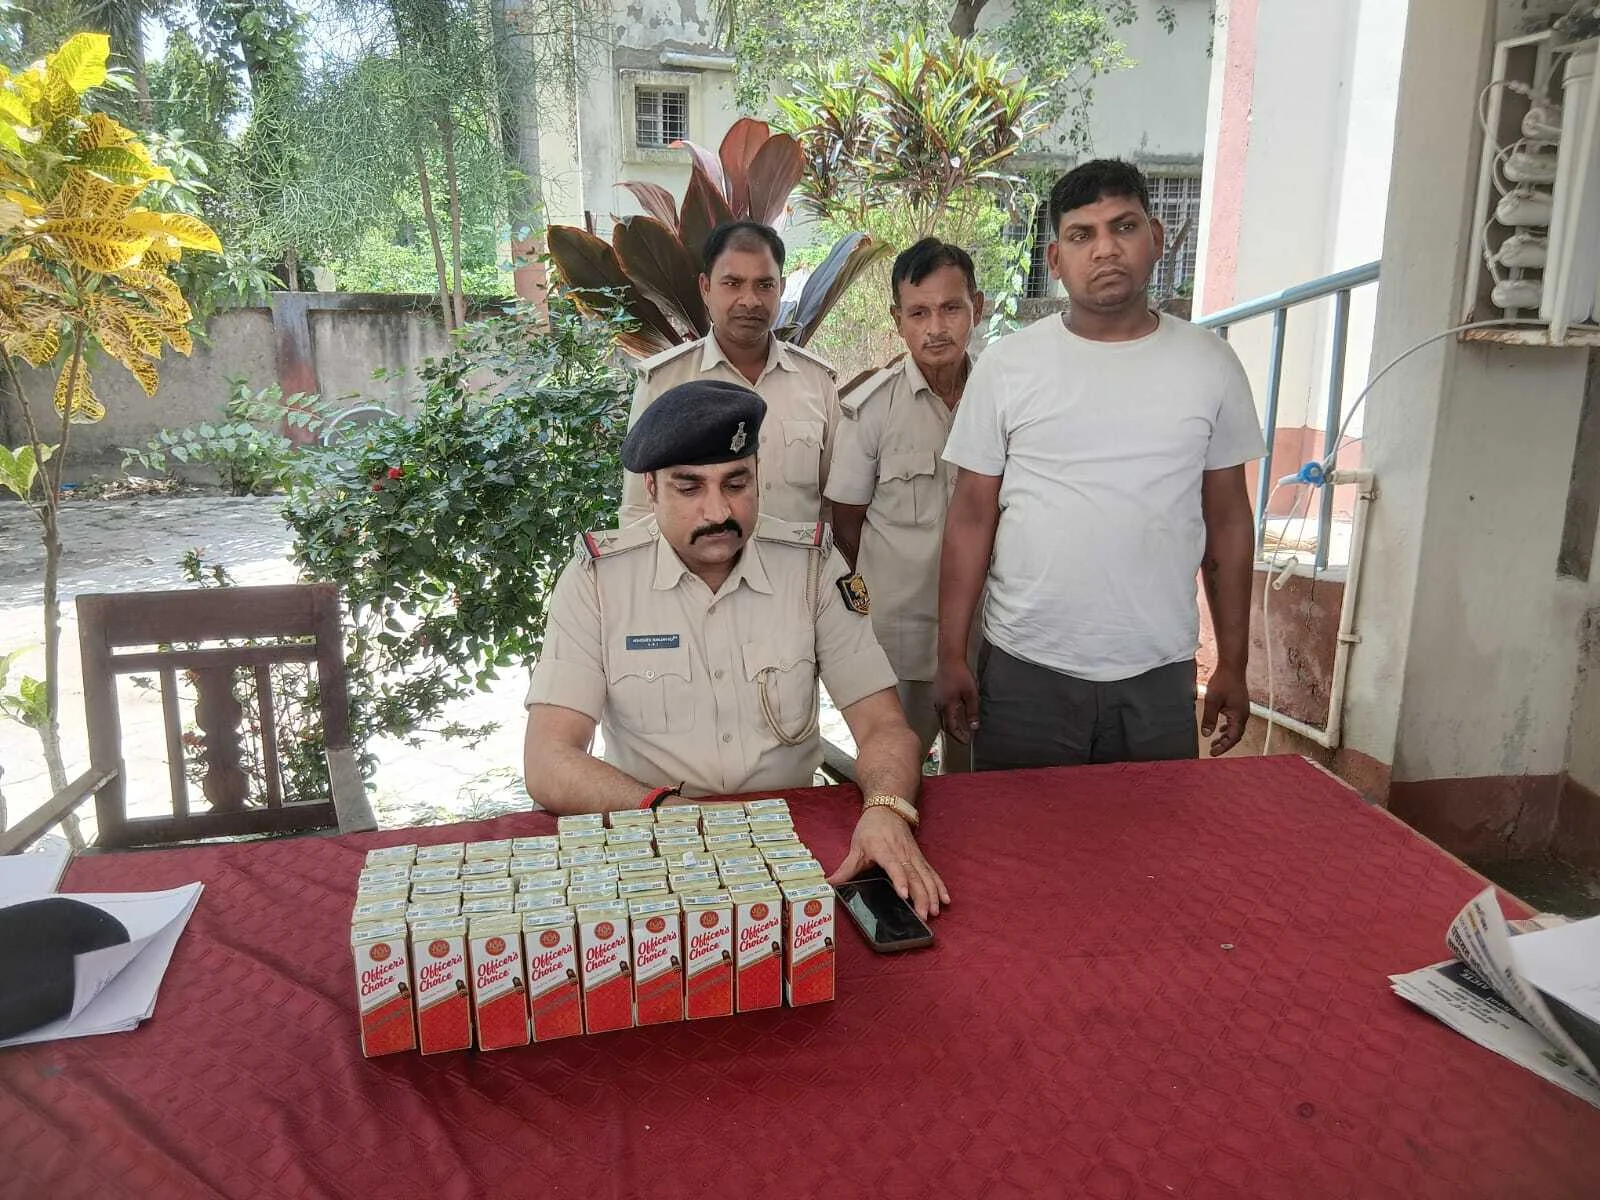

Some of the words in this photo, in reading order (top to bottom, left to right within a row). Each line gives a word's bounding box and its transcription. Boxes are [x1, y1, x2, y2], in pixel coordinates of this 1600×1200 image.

[741, 917, 779, 941] Officer's
[796, 913, 832, 936] Officer's
[638, 931, 677, 955] Officer's
[691, 926, 730, 948] Officer's
[740, 934, 769, 952] Choice
[794, 930, 823, 949] Choice
[532, 944, 573, 969] Officer's
[586, 936, 626, 961] Officer's
[637, 948, 667, 967] Choice
[689, 942, 719, 960] Choice
[361, 957, 405, 983] Officer's
[420, 954, 463, 981] Officer's
[478, 952, 519, 976] Officer's
[532, 961, 562, 981] Choice
[585, 953, 616, 972] Choice
[361, 975, 395, 995] Choice
[420, 971, 452, 992] Choice
[477, 970, 509, 988] Choice
